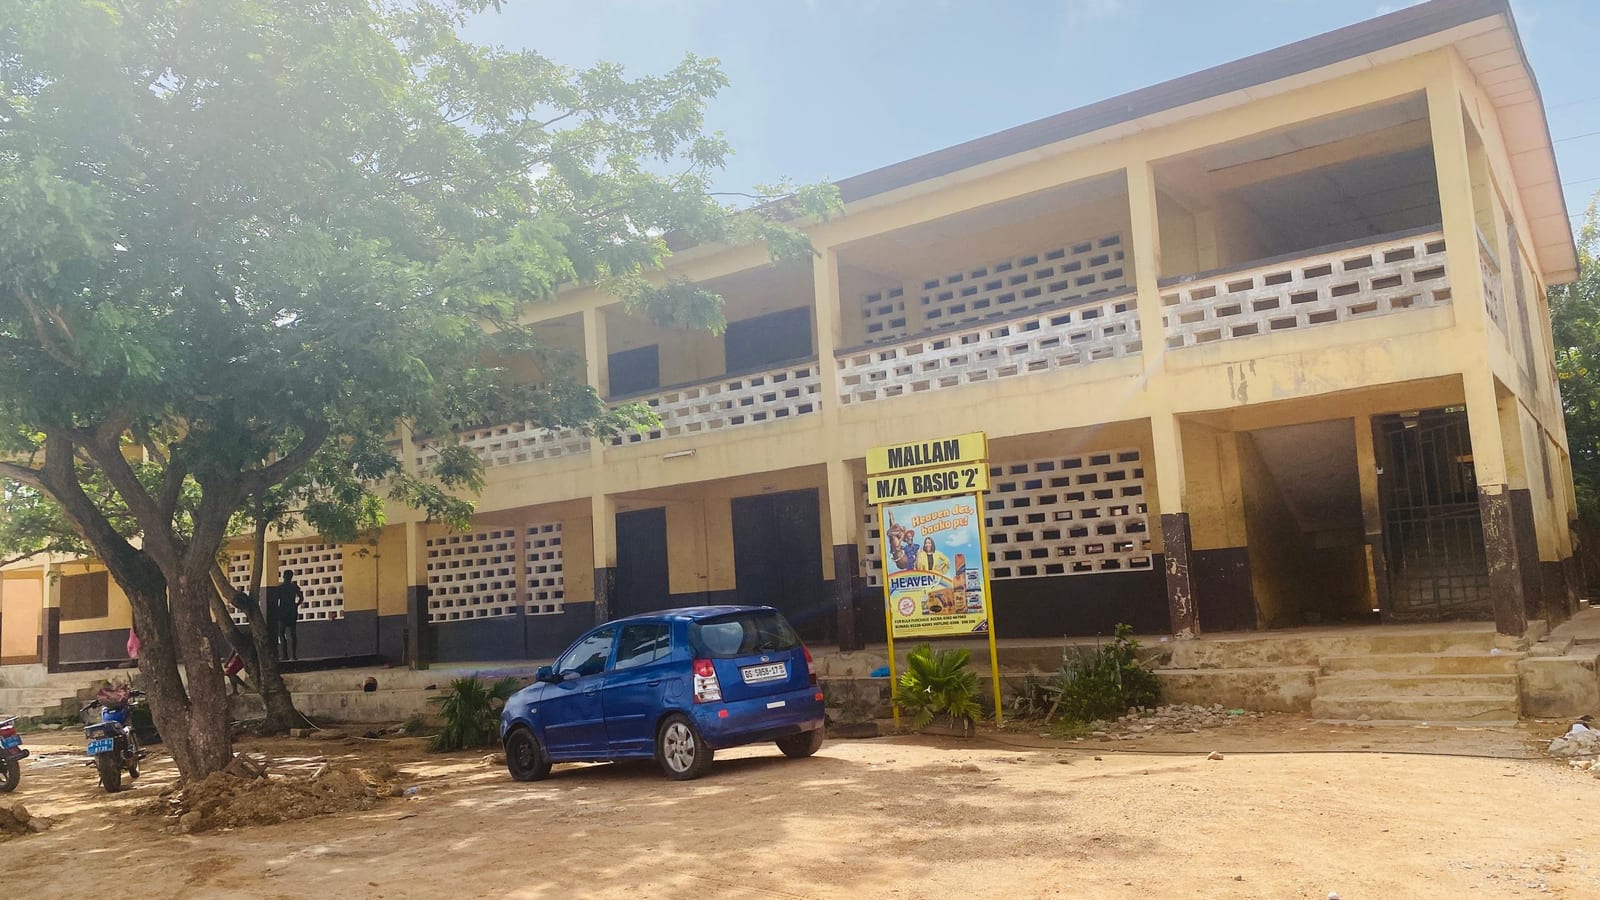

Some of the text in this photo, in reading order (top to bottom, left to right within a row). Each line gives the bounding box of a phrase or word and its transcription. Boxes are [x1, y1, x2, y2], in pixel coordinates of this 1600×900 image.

[888, 439, 960, 469] MALLAM
[876, 477, 908, 499] M/A
[912, 471, 959, 495] BASIC
[912, 509, 950, 528] Heaven
[921, 520, 951, 536] baako
[891, 575, 936, 588] HEAVEN
